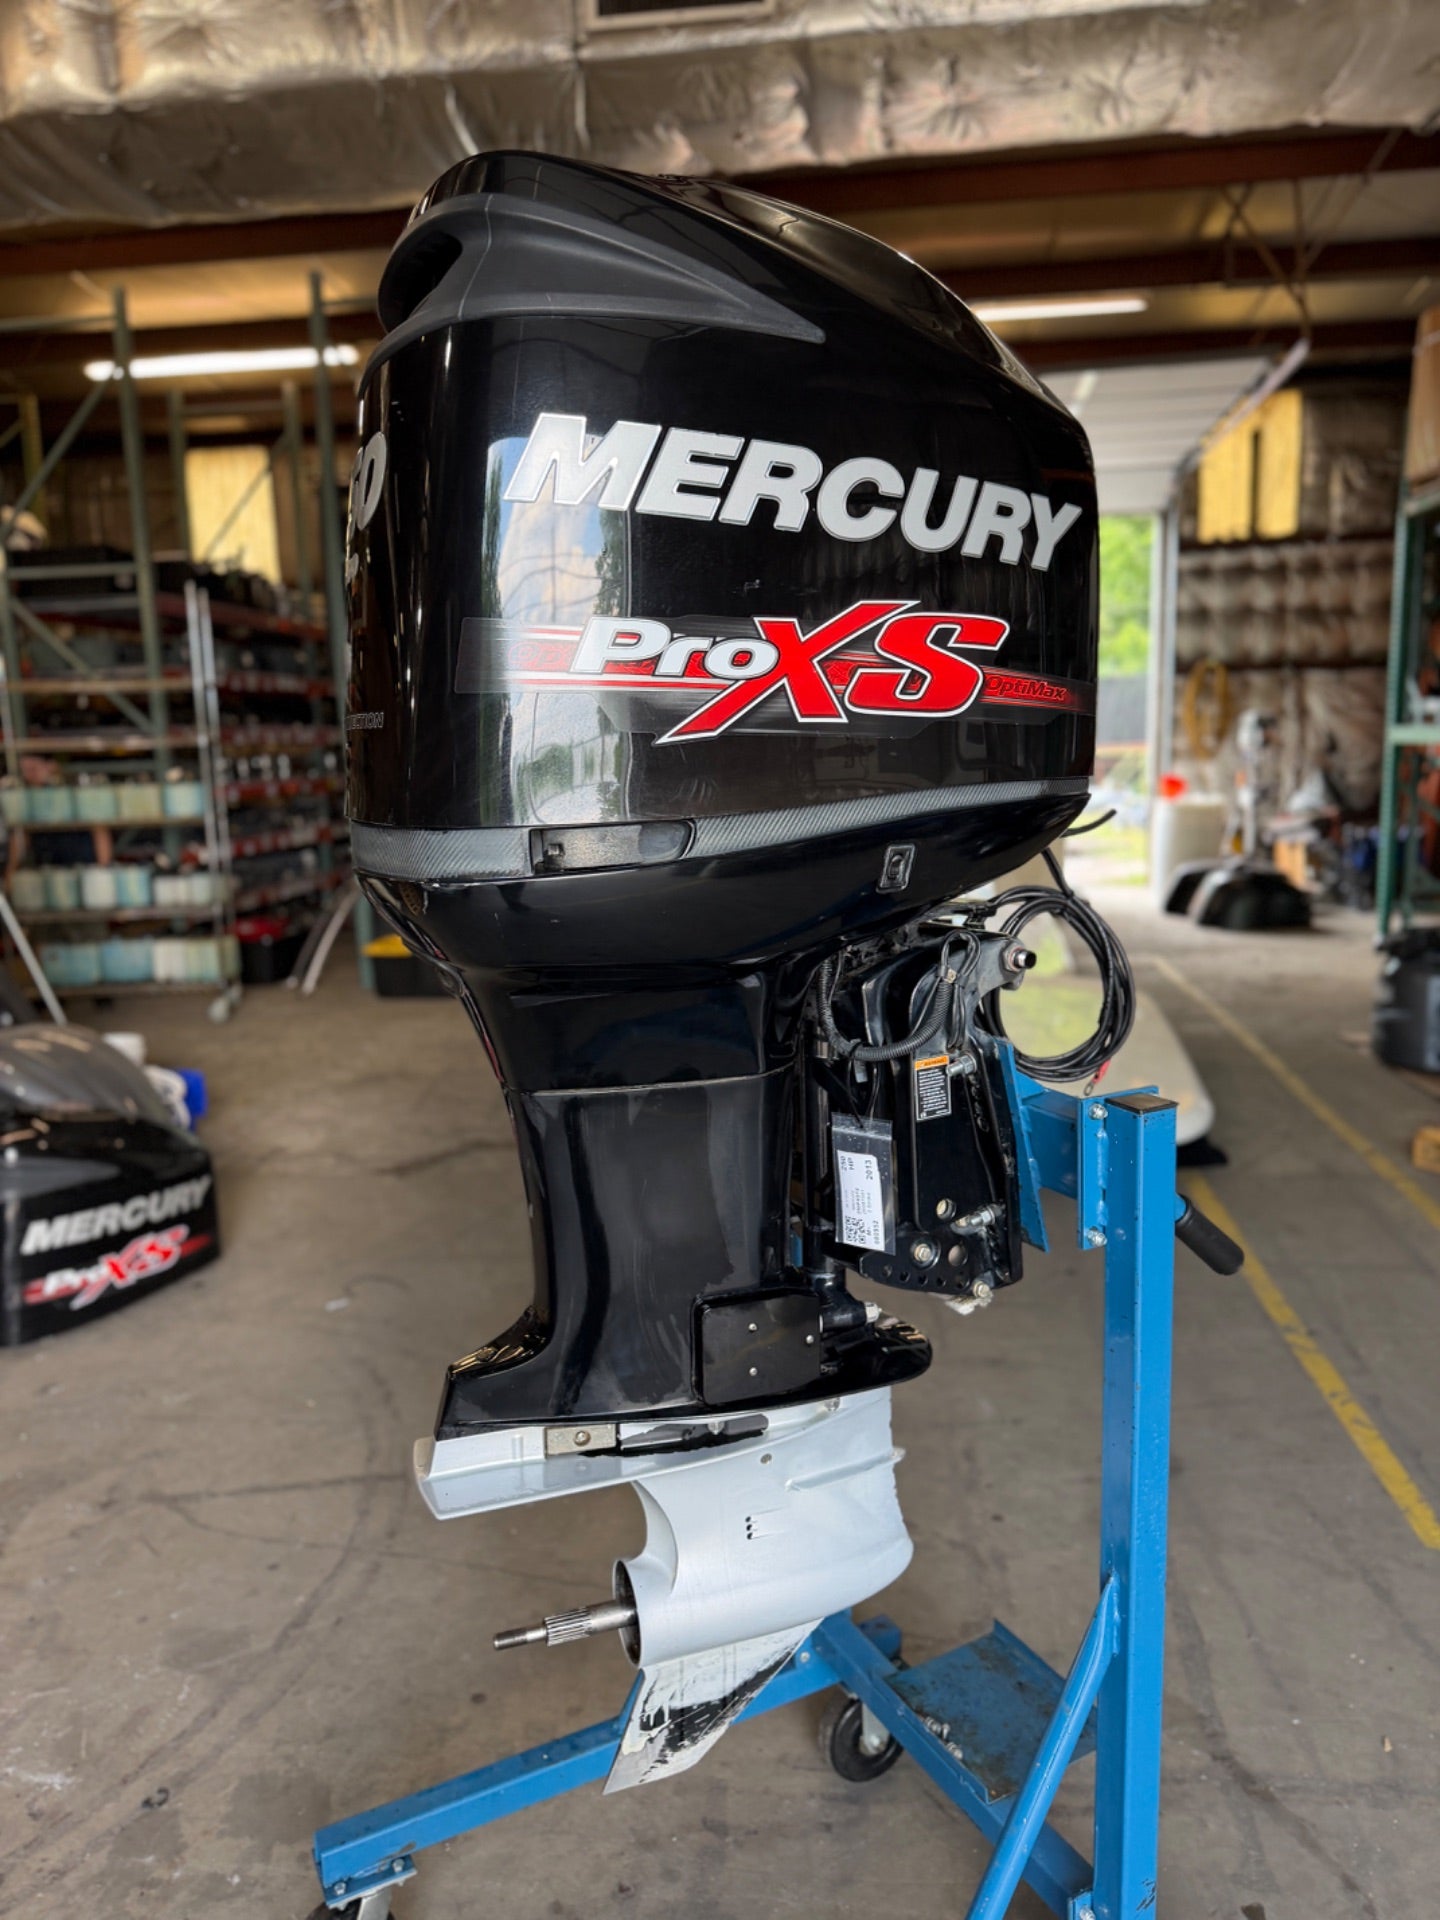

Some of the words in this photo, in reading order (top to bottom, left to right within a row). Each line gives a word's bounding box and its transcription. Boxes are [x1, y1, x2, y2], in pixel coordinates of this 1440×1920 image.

[502, 412, 1083, 572] MERCURY
[984, 674, 1067, 701] OptiMax
[20, 1174, 212, 1255] MERCURY
